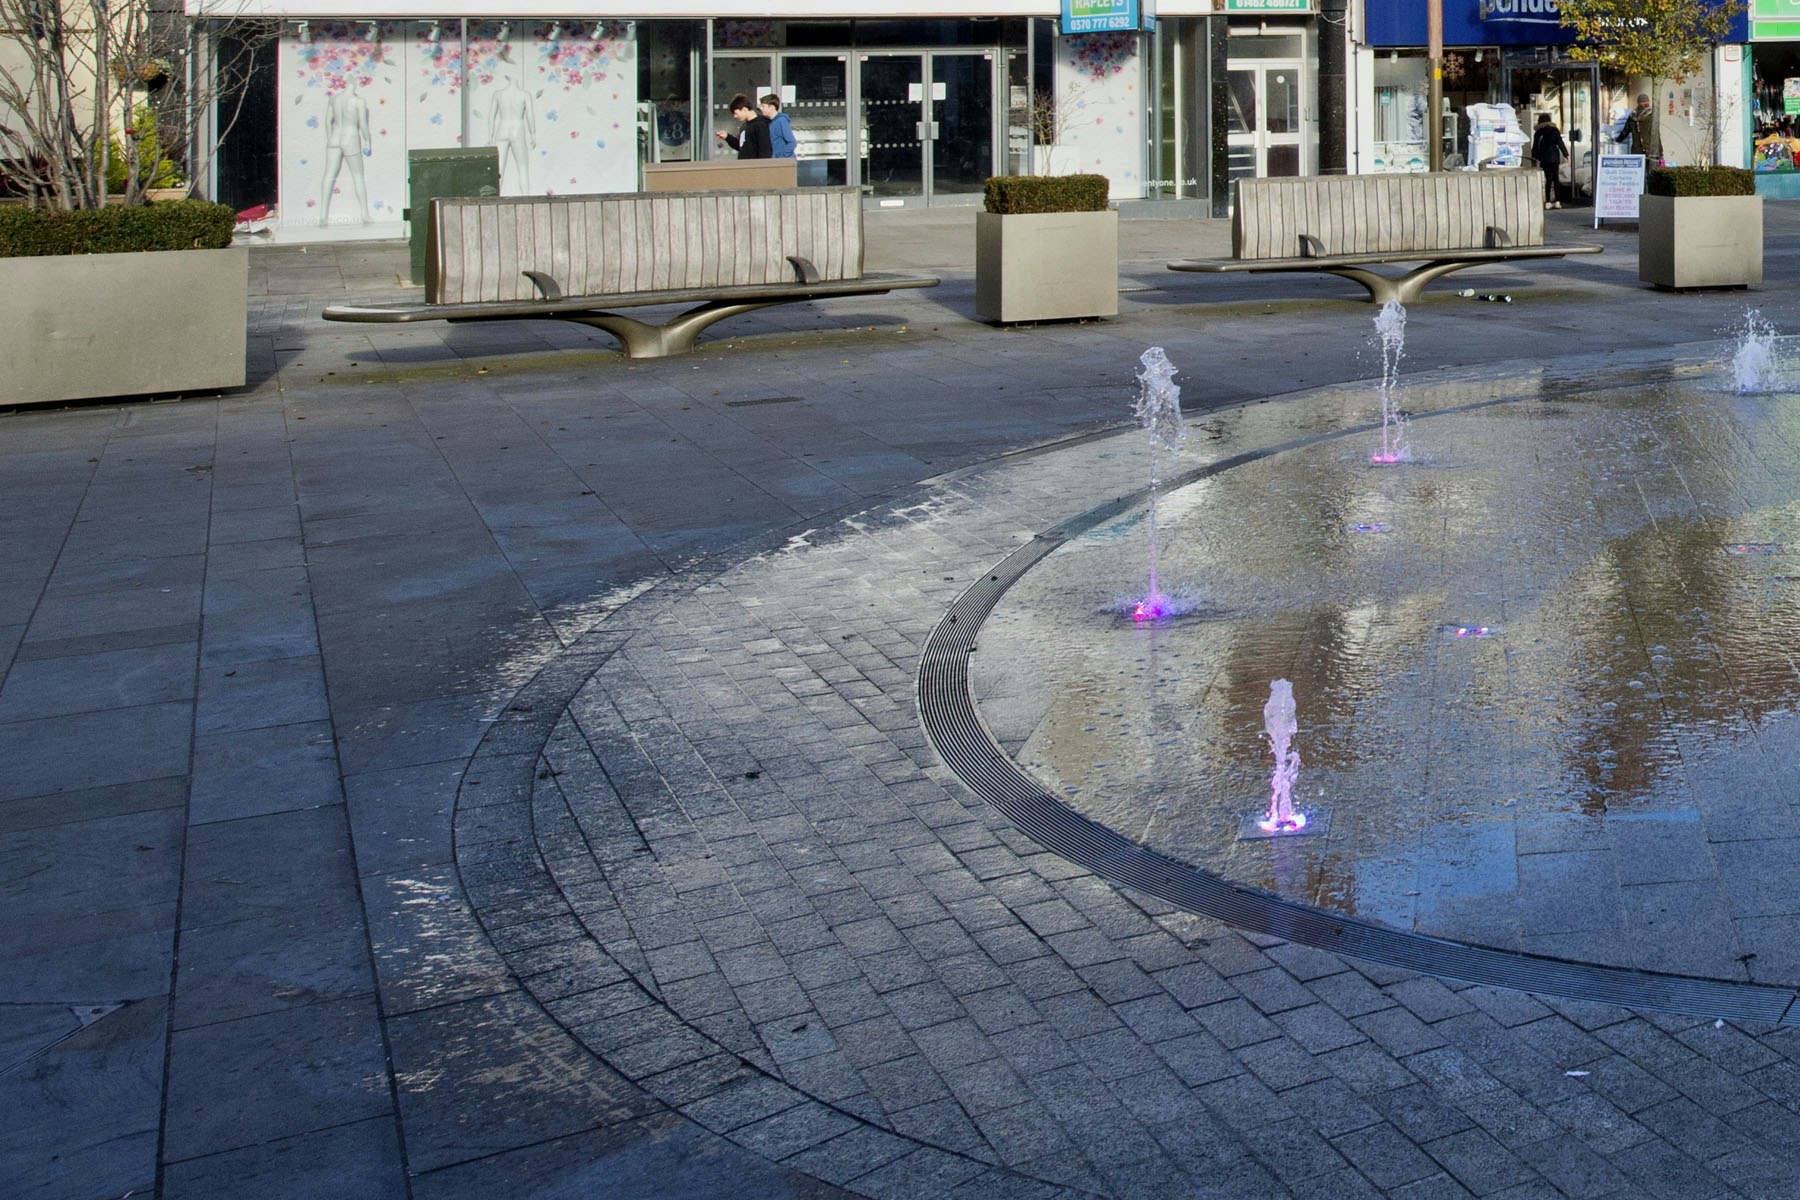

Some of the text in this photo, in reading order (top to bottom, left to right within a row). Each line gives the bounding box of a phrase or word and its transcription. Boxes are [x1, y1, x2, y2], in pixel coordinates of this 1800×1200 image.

[1071, 19, 1091, 30] 0370
[1093, 18, 1107, 29] 777
[1109, 16, 1129, 28] 6292
